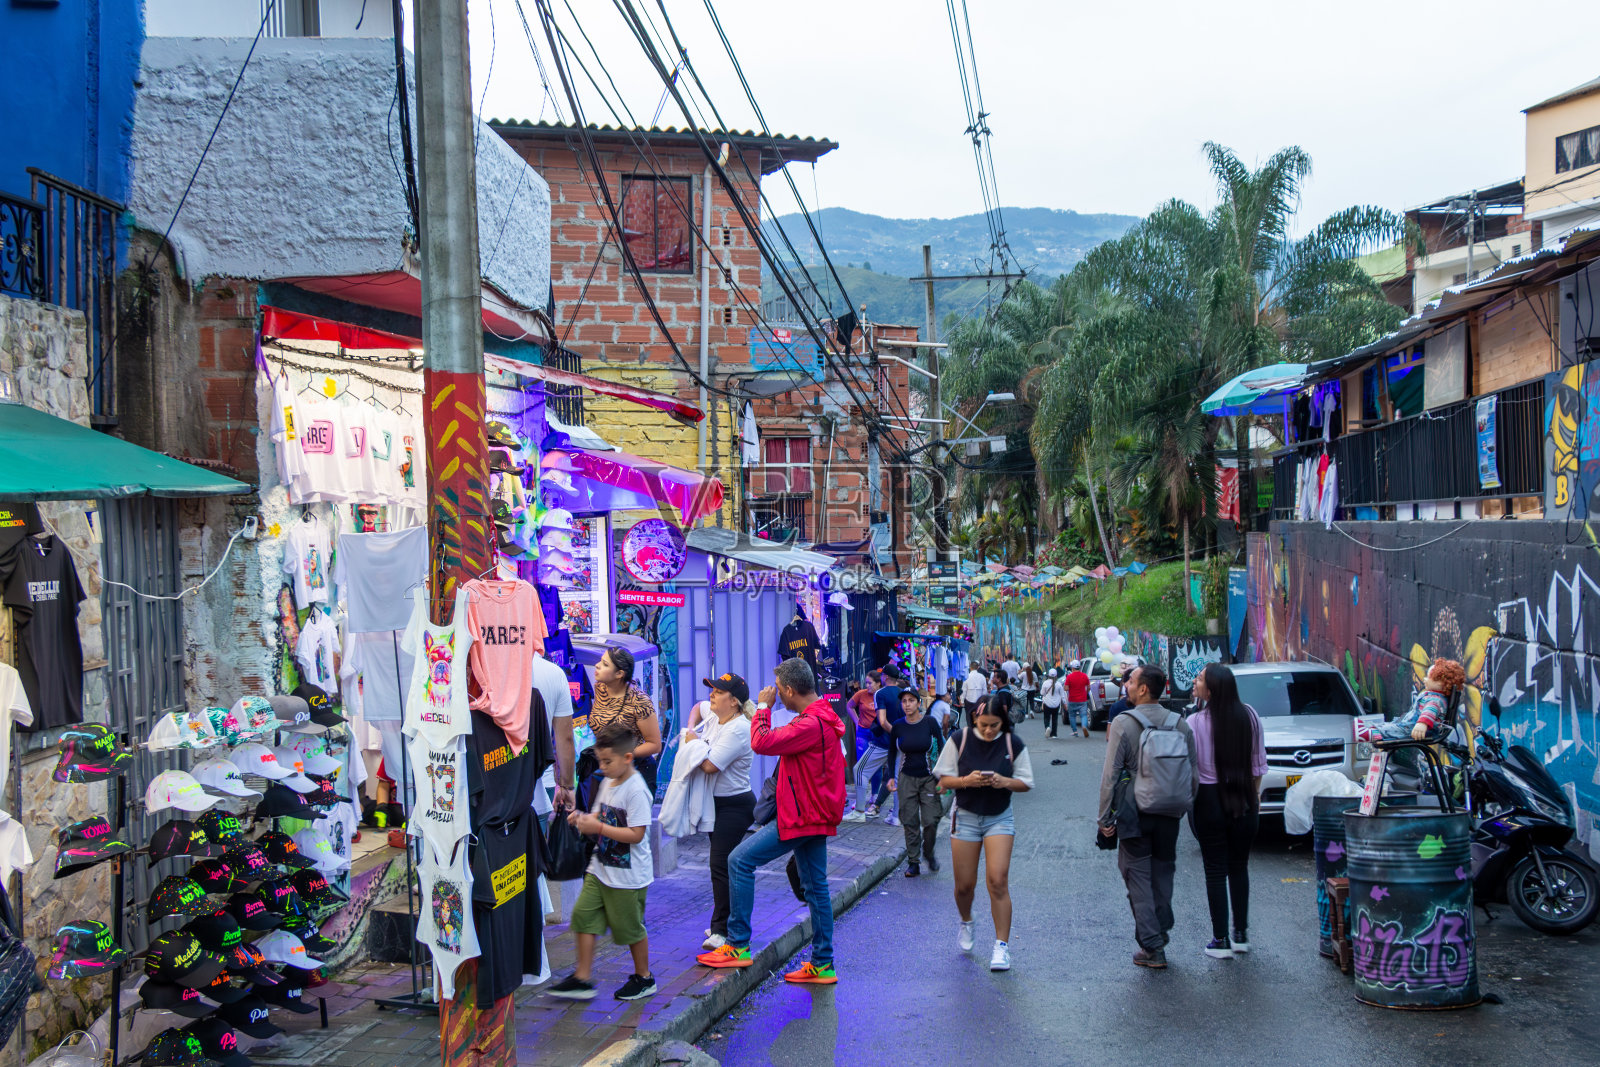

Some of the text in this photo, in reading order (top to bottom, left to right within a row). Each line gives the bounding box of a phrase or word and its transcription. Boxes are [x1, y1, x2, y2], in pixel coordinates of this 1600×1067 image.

[619, 593, 682, 605] SIENTE EL SABOR
